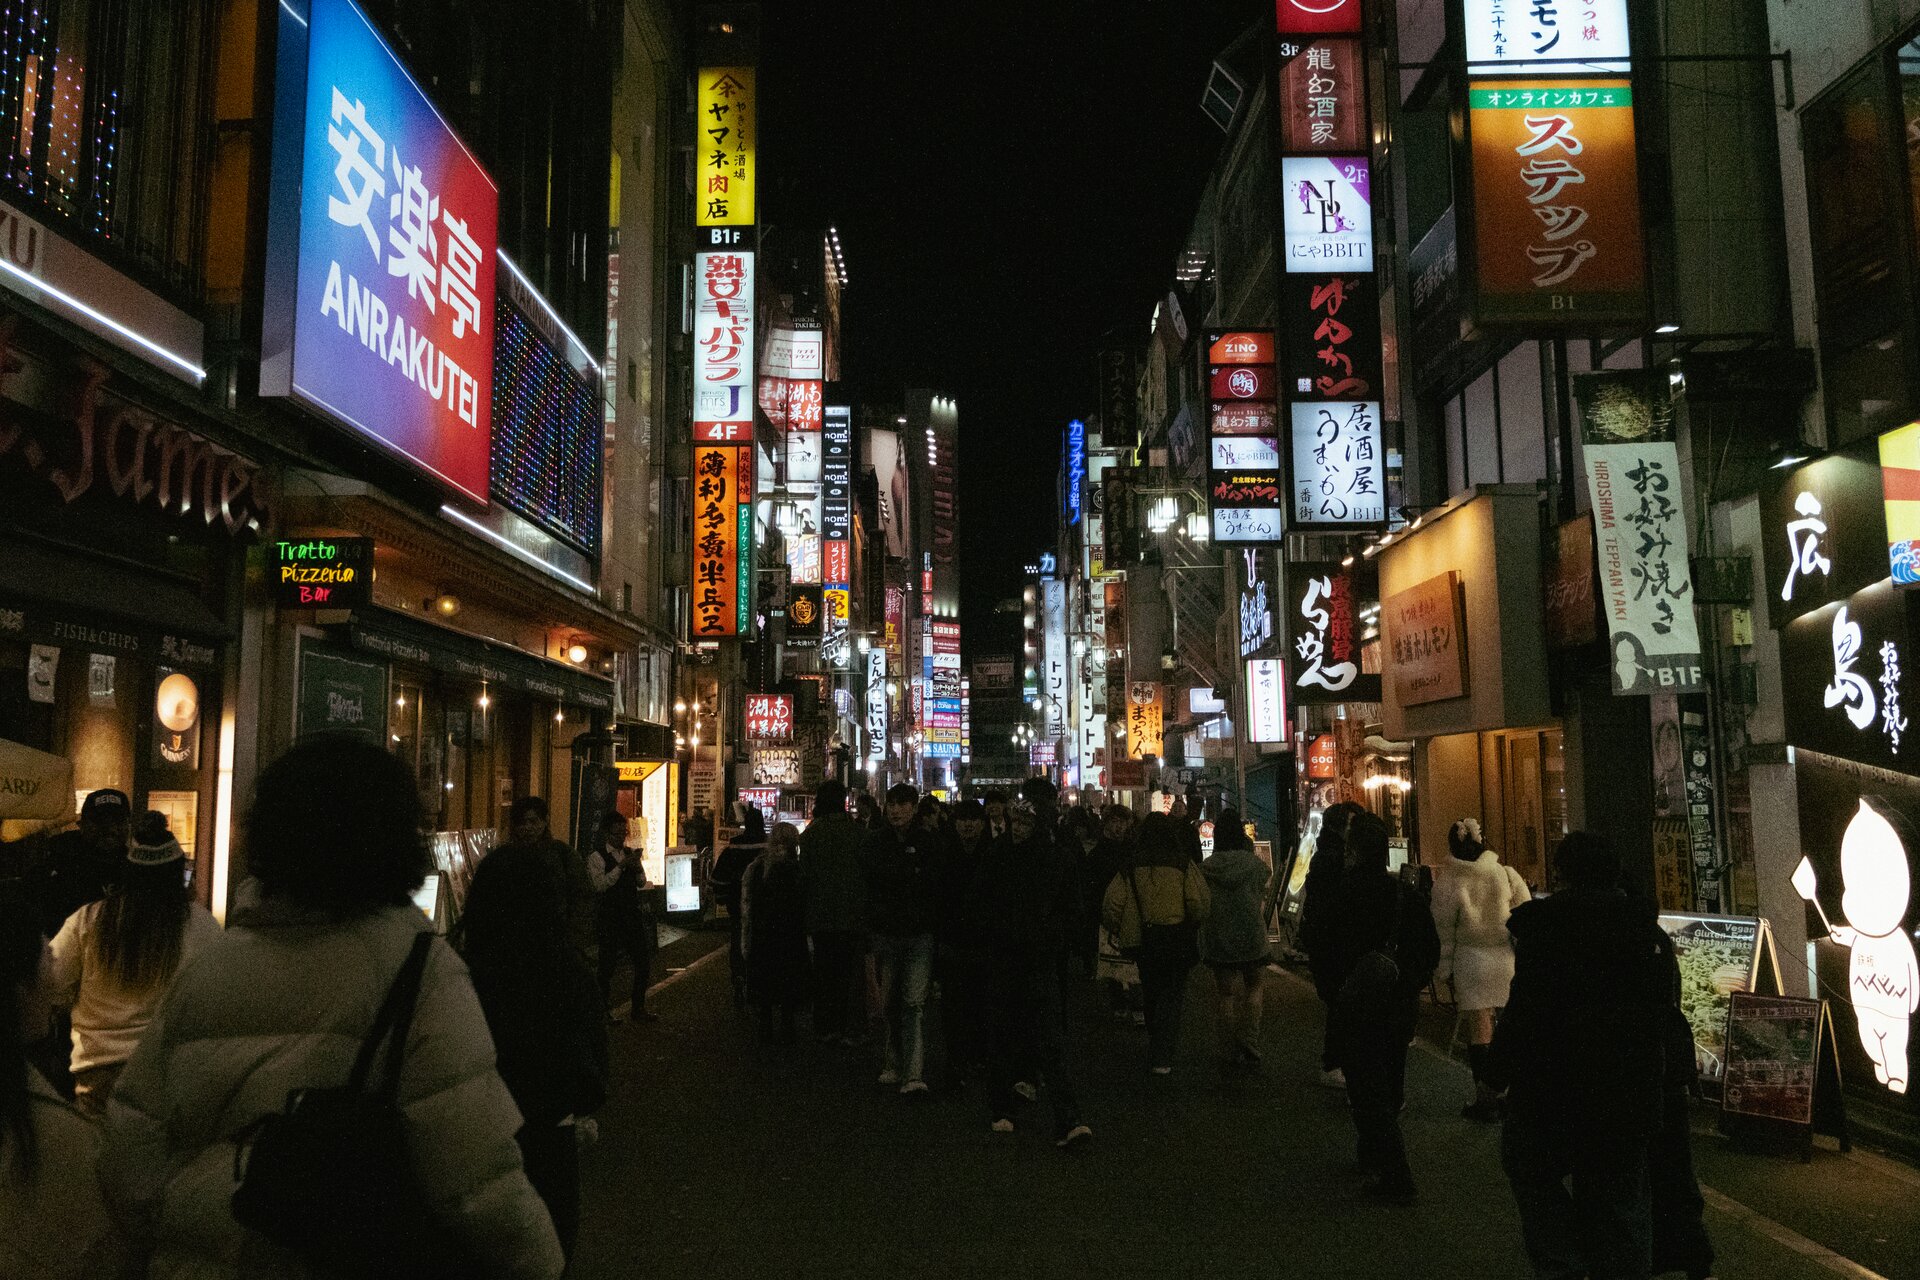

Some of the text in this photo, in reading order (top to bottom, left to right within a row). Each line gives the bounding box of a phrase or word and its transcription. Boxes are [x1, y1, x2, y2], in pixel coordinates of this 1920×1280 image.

[1530, 0, 1560, 54] モン
[1281, 43, 1299, 56] 3F
[1306, 48, 1337, 144] 龍幻酒家
[1488, 92, 1615, 106] オンラインカフェ
[733, 101, 746, 181] やきとん酒場
[705, 103, 730, 220] ヤマネ肉店
[1344, 165, 1368, 183] 2F
[1516, 114, 1597, 288] ステップ
[328, 85, 482, 340] 安楽亭
[711, 229, 740, 244] B1F
[1292, 243, 1366, 260] にゃBBIT
[1551, 296, 1575, 310] B1
[700, 255, 750, 383] 熟女キャバクラ
[320, 260, 479, 428] ANRAKUTEI
[1225, 344, 1258, 353] ZINO
[700, 395, 725, 407] mrs
[1215, 416, 1274, 428] 龍幻酒家
[708, 424, 737, 441] 4F
[1344, 403, 1377, 495] 居酒屋
[1313, 410, 1348, 520] うまいもん
[1298, 479, 1314, 521] 一番街
[1594, 460, 1616, 529] HIROSHIMA
[1216, 509, 1252, 520] 居酒屋
[1353, 507, 1382, 521] B1F
[1225, 520, 1272, 535] うまいもん
[1620, 459, 1688, 634] お好み焼き
[803, 537, 819, 582] 出会い
[281, 563, 354, 583] Pizzeria
[299, 586, 332, 603] Bar
[1657, 667, 1701, 687] B1F
[750, 698, 788, 718] 湖南
[871, 653, 884, 754] とんかにいむら
[1880, 641, 1908, 755] お好み焼き
[757, 721, 787, 737] 菜館
[1084, 682, 1096, 769] トントン
[1132, 705, 1147, 756] まっちゃん
[933, 744, 961, 754] SAUNA
[1725, 924, 1755, 934] Vegan
[1698, 937, 1752, 949] Restaurants
